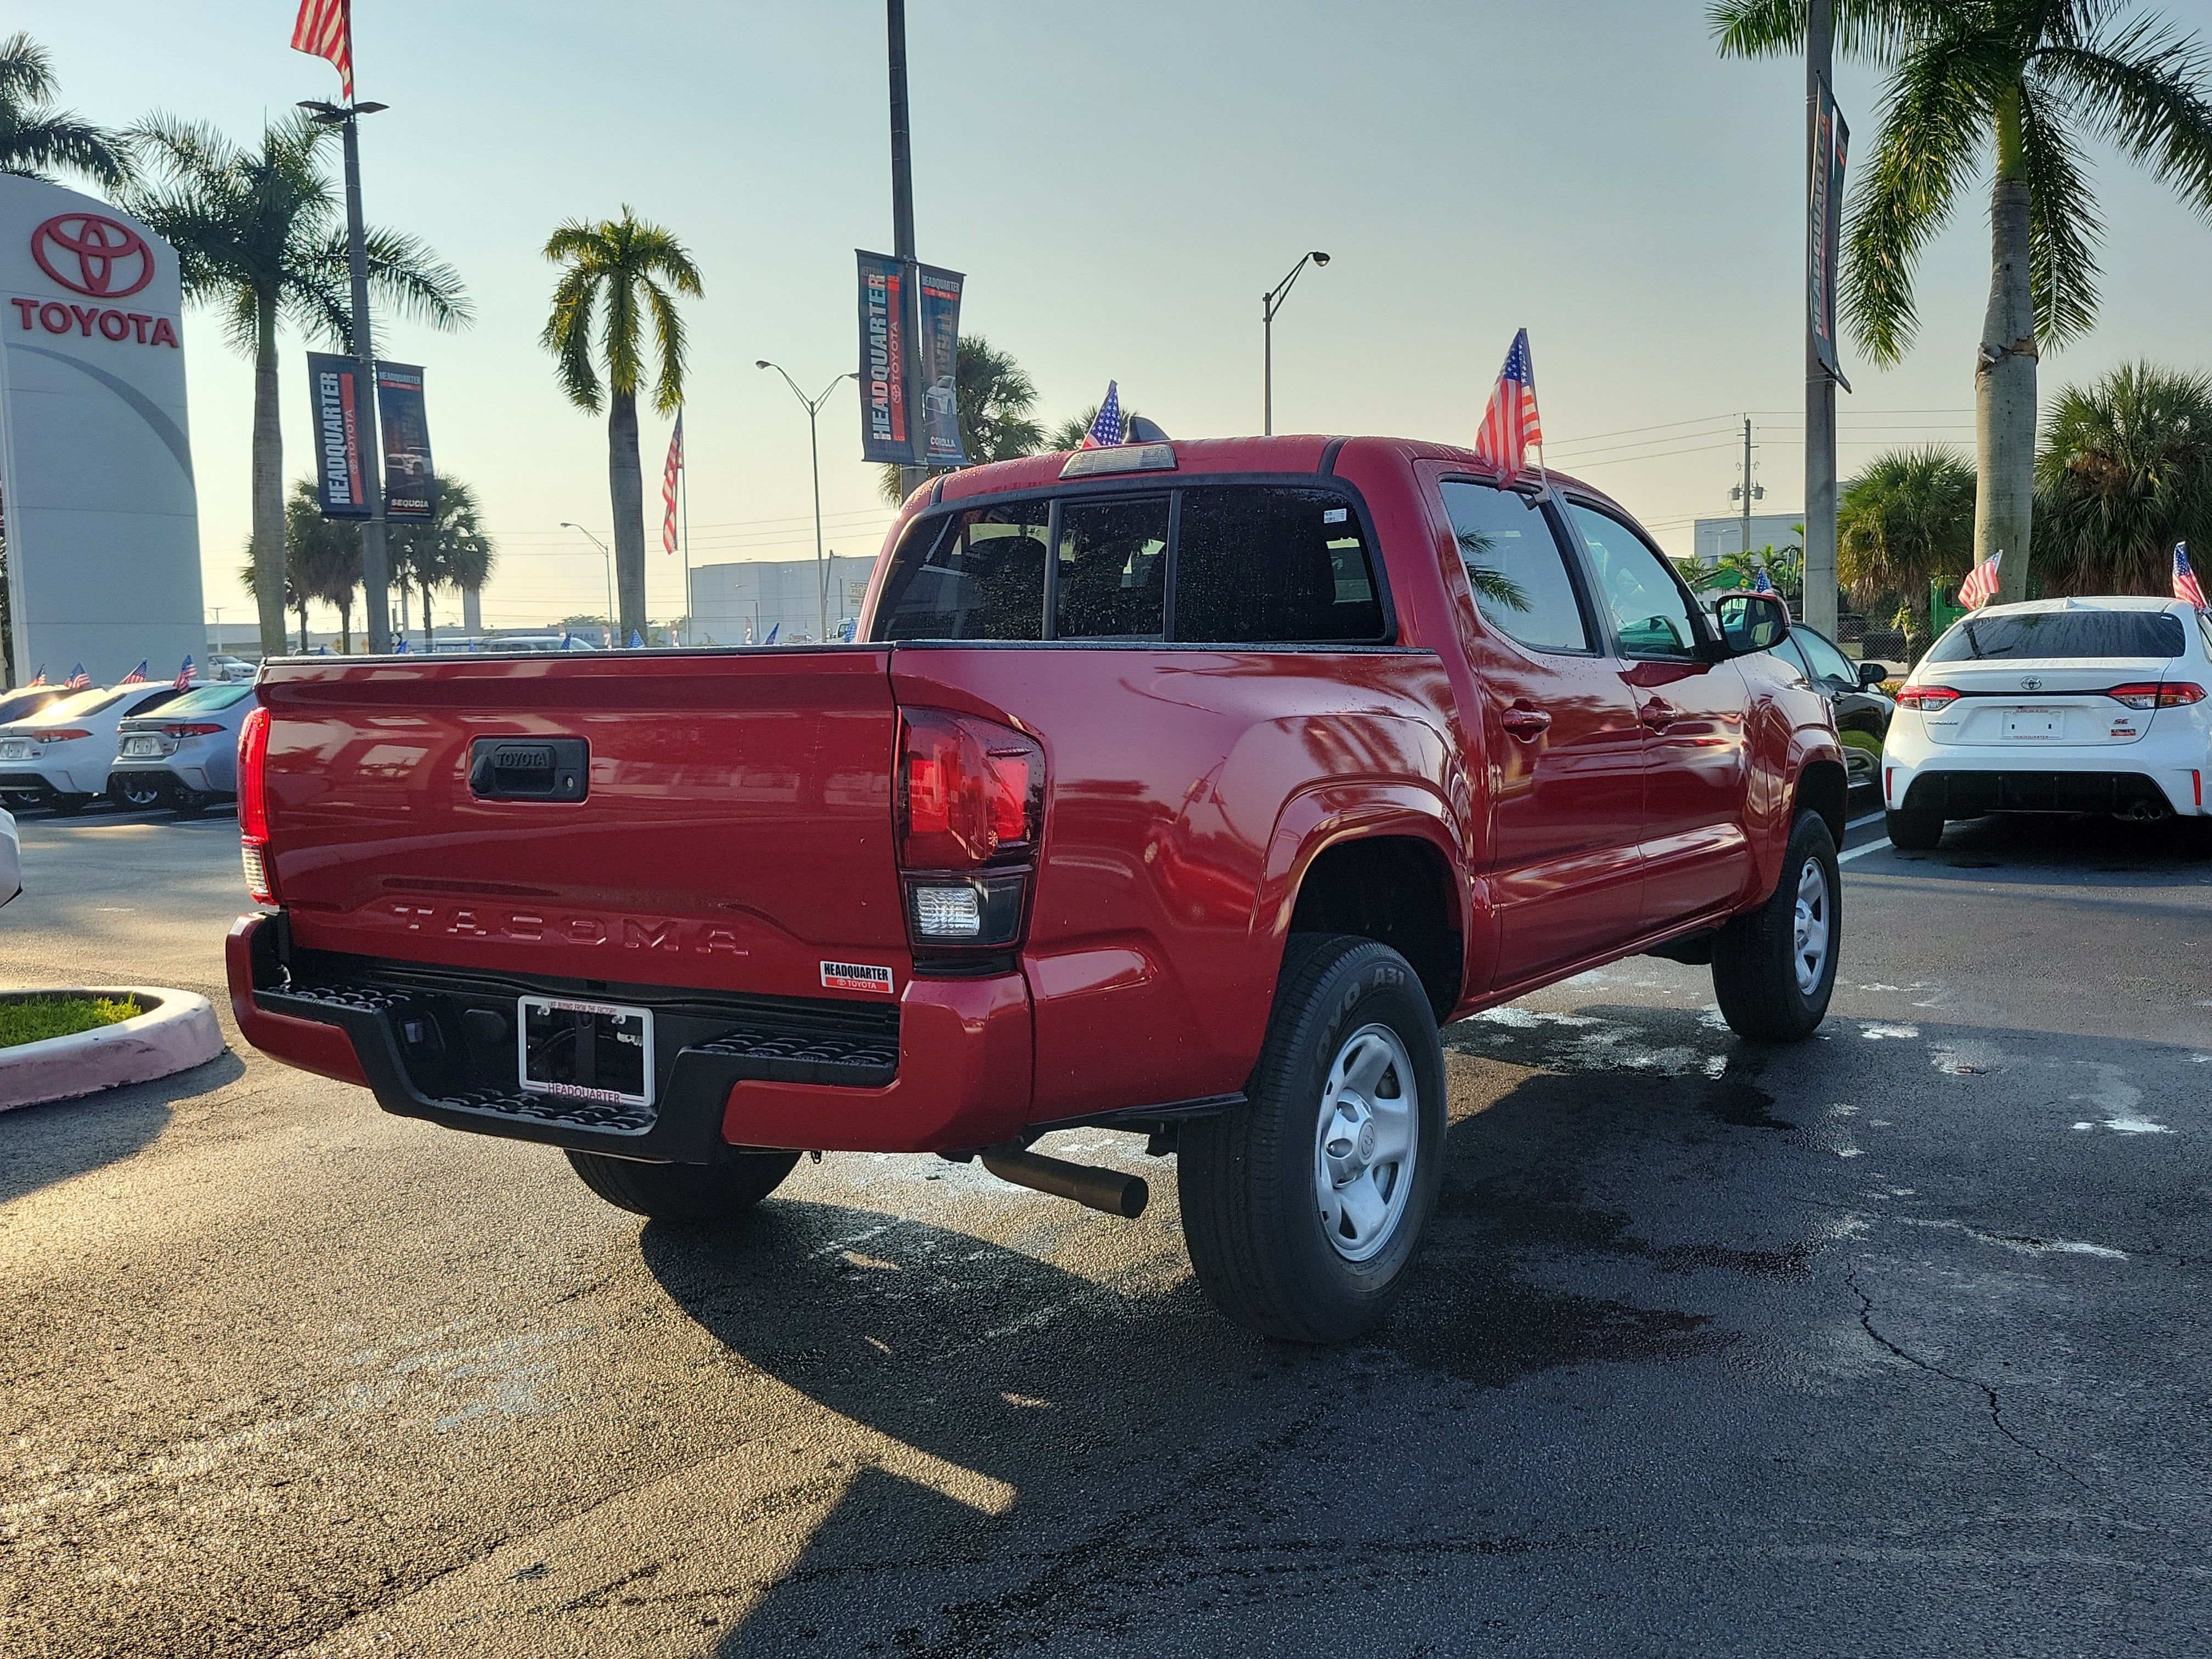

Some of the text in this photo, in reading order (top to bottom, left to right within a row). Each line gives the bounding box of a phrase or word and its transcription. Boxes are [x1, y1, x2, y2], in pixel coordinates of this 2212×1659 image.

[1813, 111, 1825, 336] HEADQUARTER
[922, 275, 960, 293] HEADQUARTER
[12, 298, 179, 348] TOYOTA
[868, 274, 891, 441] HEADQUARTER
[891, 322, 900, 382] TOYOTA
[320, 373, 351, 504] HEADQUARTER
[345, 410, 357, 456] TOYOTA
[391, 499, 429, 507] SEQUOIA
[497, 752, 548, 767] TOYOTA
[392, 903, 749, 956] TACOMA
[824, 963, 888, 981] HEADQUARTER
[847, 980, 877, 989] TOYOTA
[574, 1003, 586, 1012] FROM
[549, 1083, 620, 1103] HEADQUARTER
